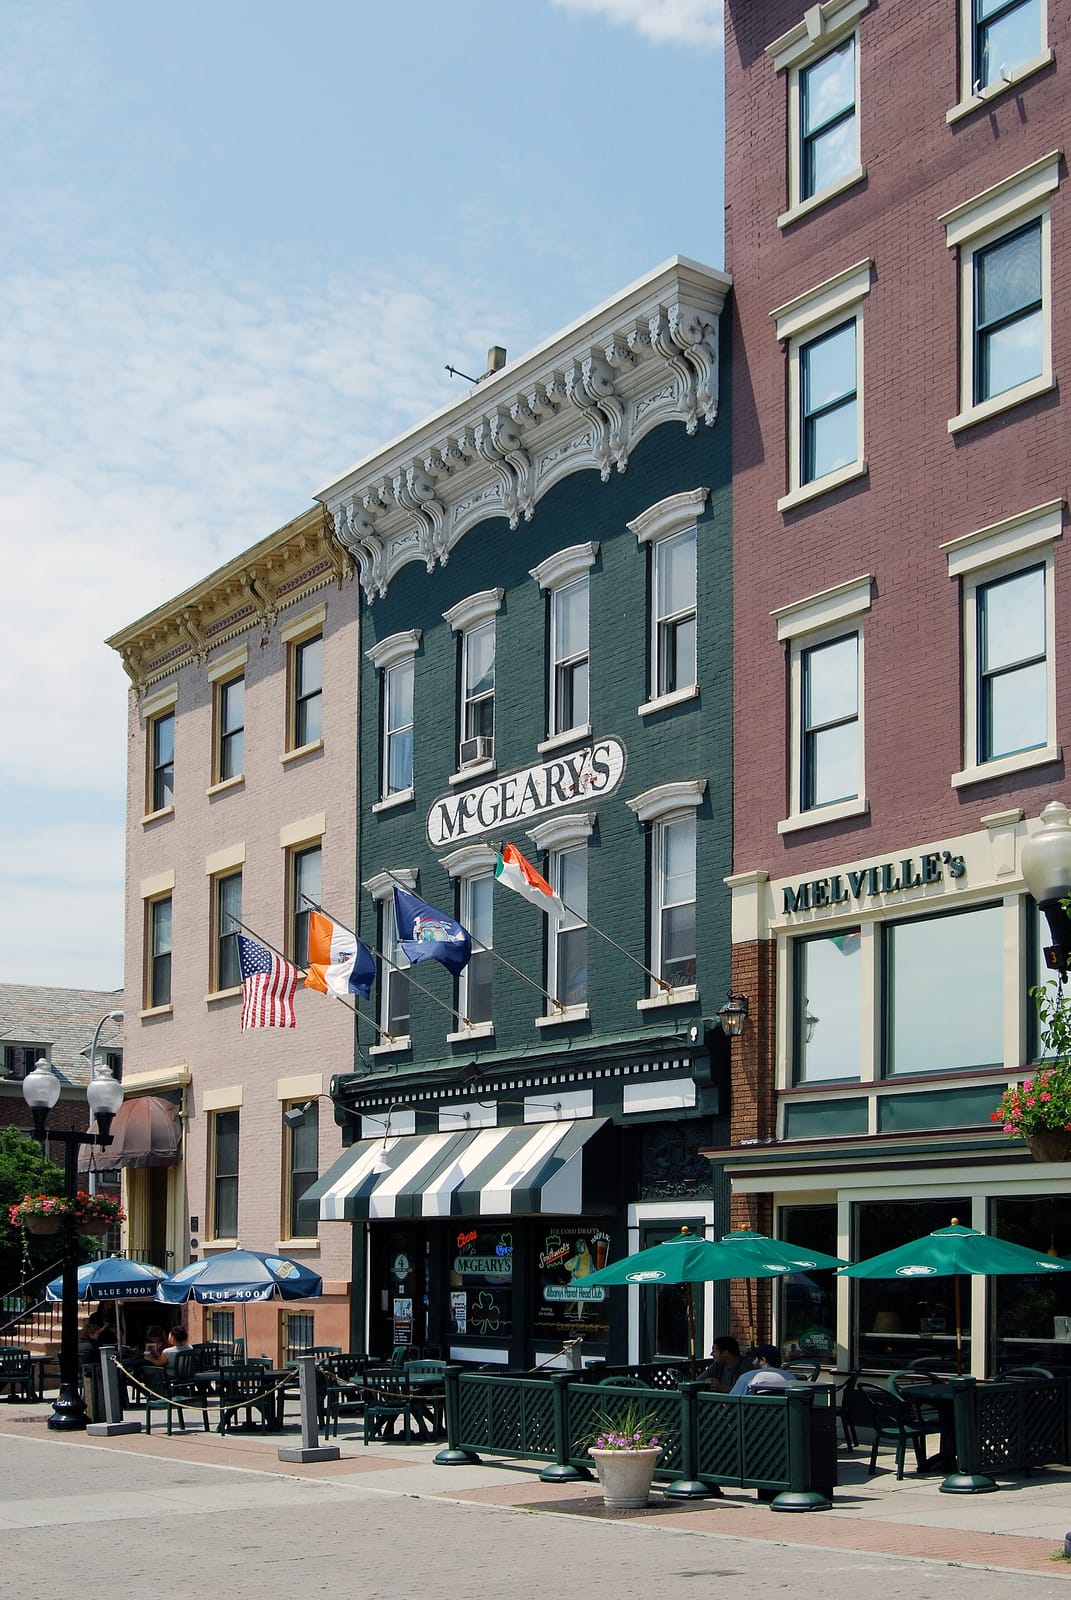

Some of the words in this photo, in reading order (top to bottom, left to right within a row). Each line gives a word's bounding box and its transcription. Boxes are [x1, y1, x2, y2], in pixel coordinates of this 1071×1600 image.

[1050, 951, 1057, 964] 3
[98, 1288, 121, 1296] BLUE
[125, 1286, 152, 1295] MOON
[201, 1291, 230, 1300] BLUE
[236, 1290, 268, 1299] MOON
[579, 1286, 591, 1298] Head
[592, 1287, 603, 1299] Club
